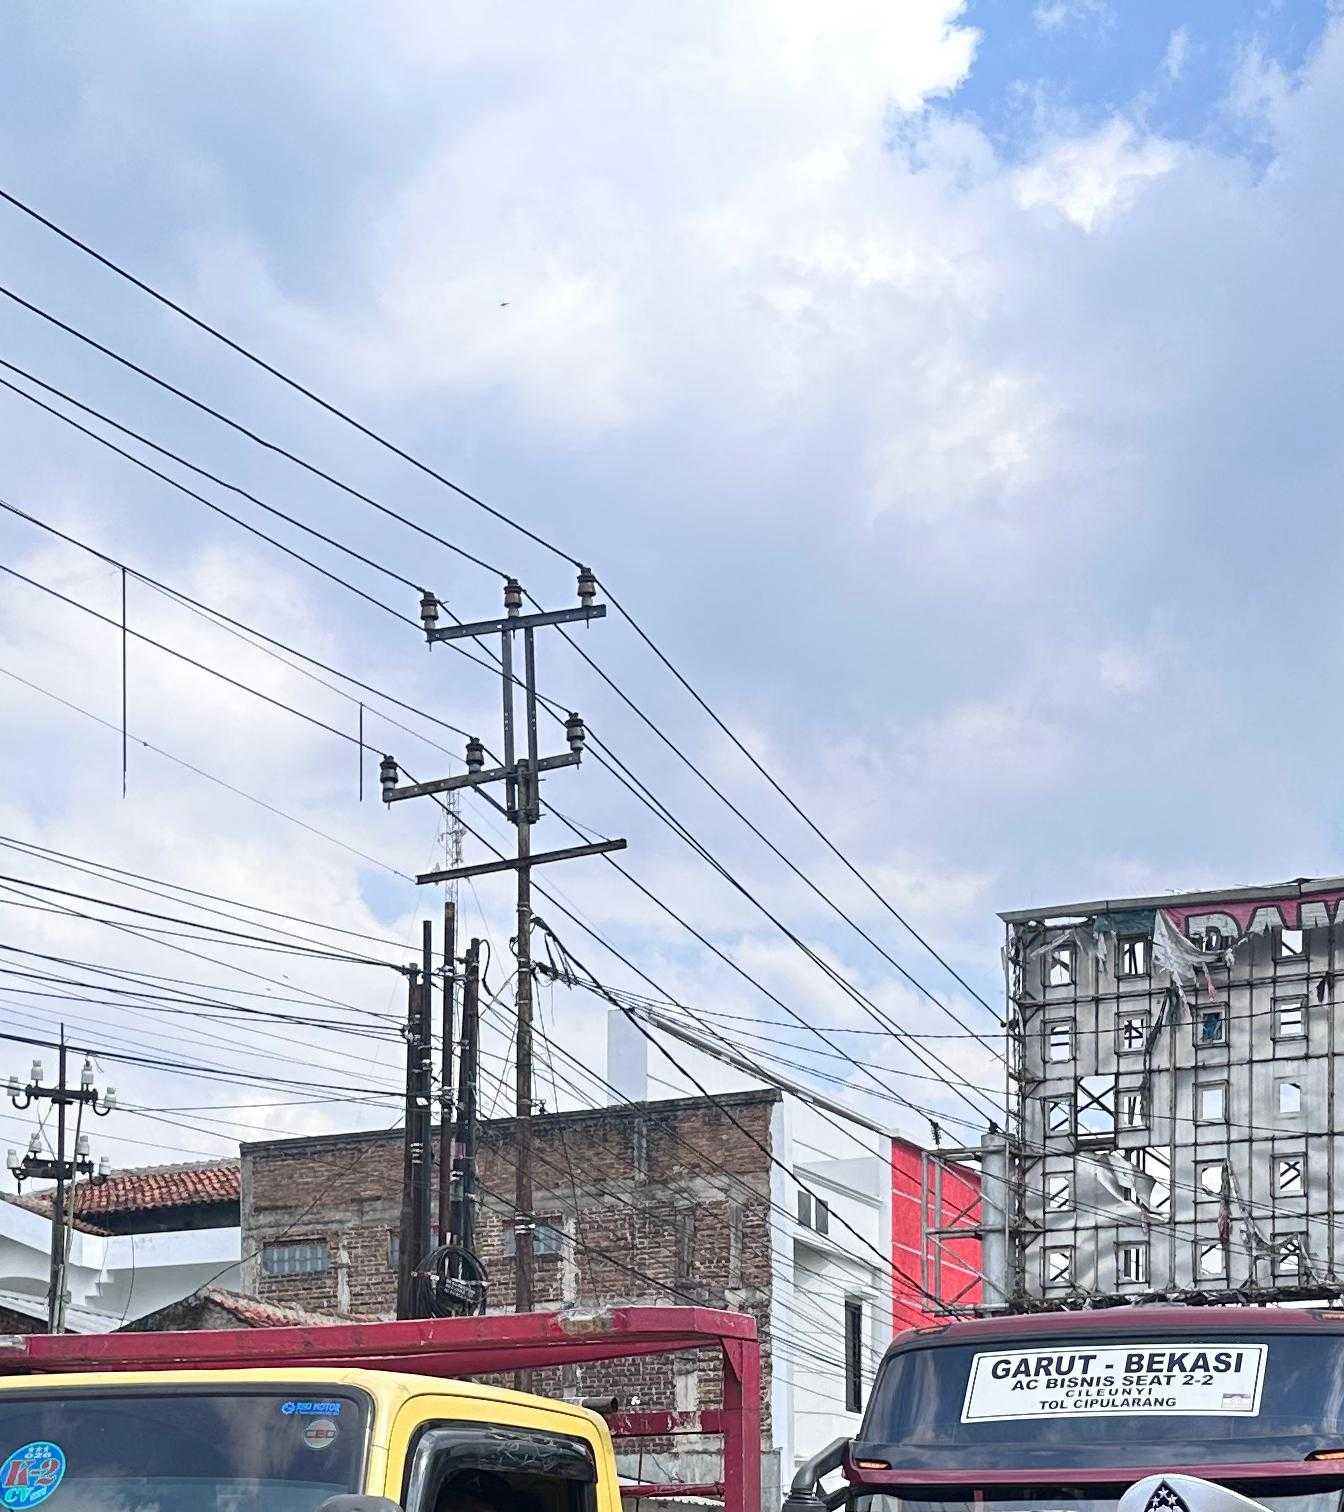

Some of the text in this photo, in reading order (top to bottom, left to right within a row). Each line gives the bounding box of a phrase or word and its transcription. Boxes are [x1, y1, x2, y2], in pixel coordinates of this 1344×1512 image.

[990, 1354, 1097, 1380] GARUT
[1123, 1352, 1244, 1374] BEKASI
[1010, 1374, 1215, 1392] AC BISNIS SEAT 2-2
[1065, 1388, 1154, 1398] CILEUNYI
[1039, 1397, 1177, 1411] TOL CIPULARANG
[1, 1458, 61, 1488] K-2
